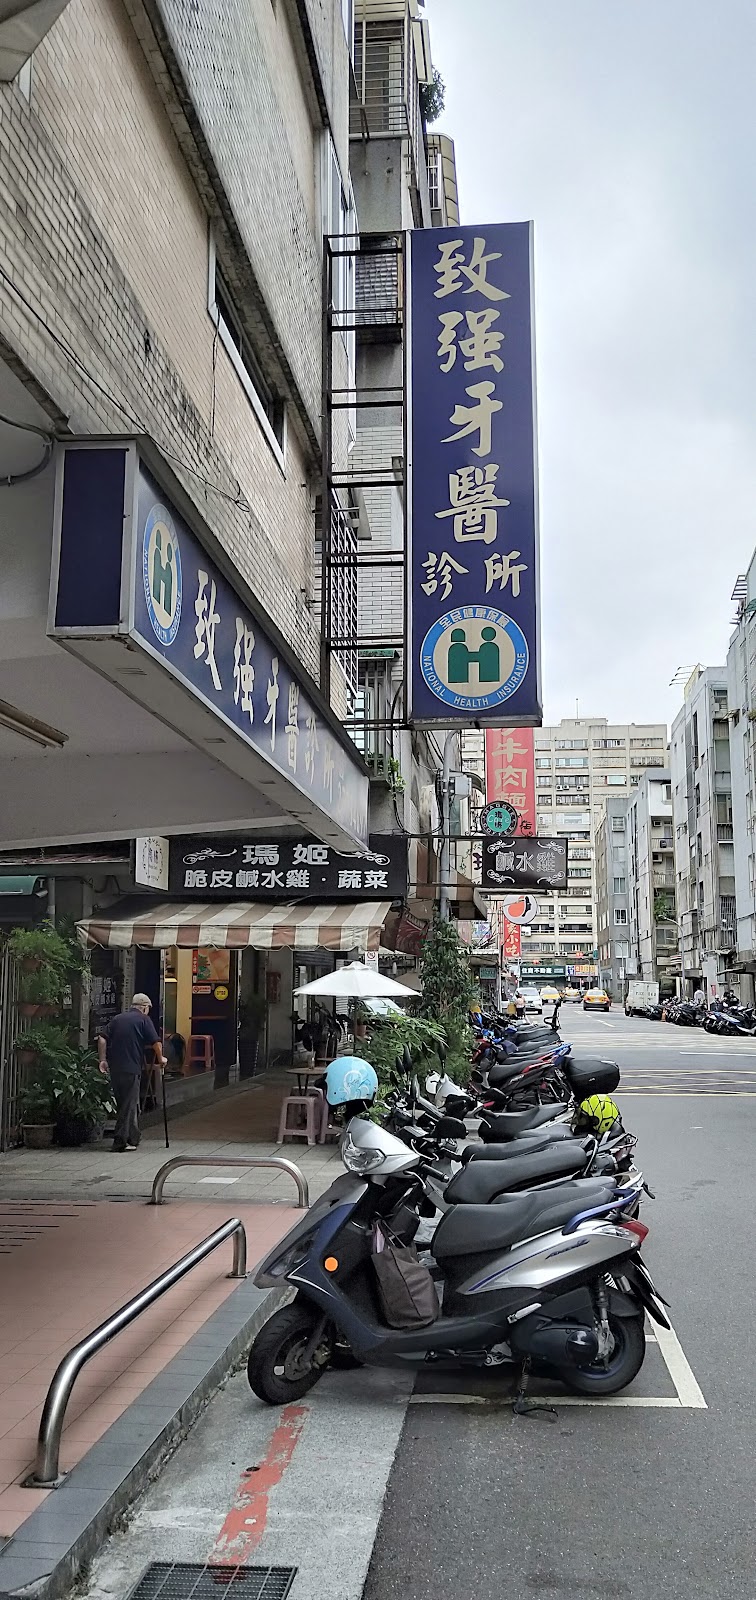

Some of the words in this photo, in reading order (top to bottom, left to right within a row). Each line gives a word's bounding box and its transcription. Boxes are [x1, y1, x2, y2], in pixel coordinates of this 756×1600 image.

[420, 550, 528, 601] 診所
[423, 655, 446, 697] NATIONAL
[453, 695, 489, 708] HEALTH
[496, 652, 526, 700] INSURANCE
[241, 843, 330, 866] 瑪姬
[495, 850, 556, 873] 鹹水雞
